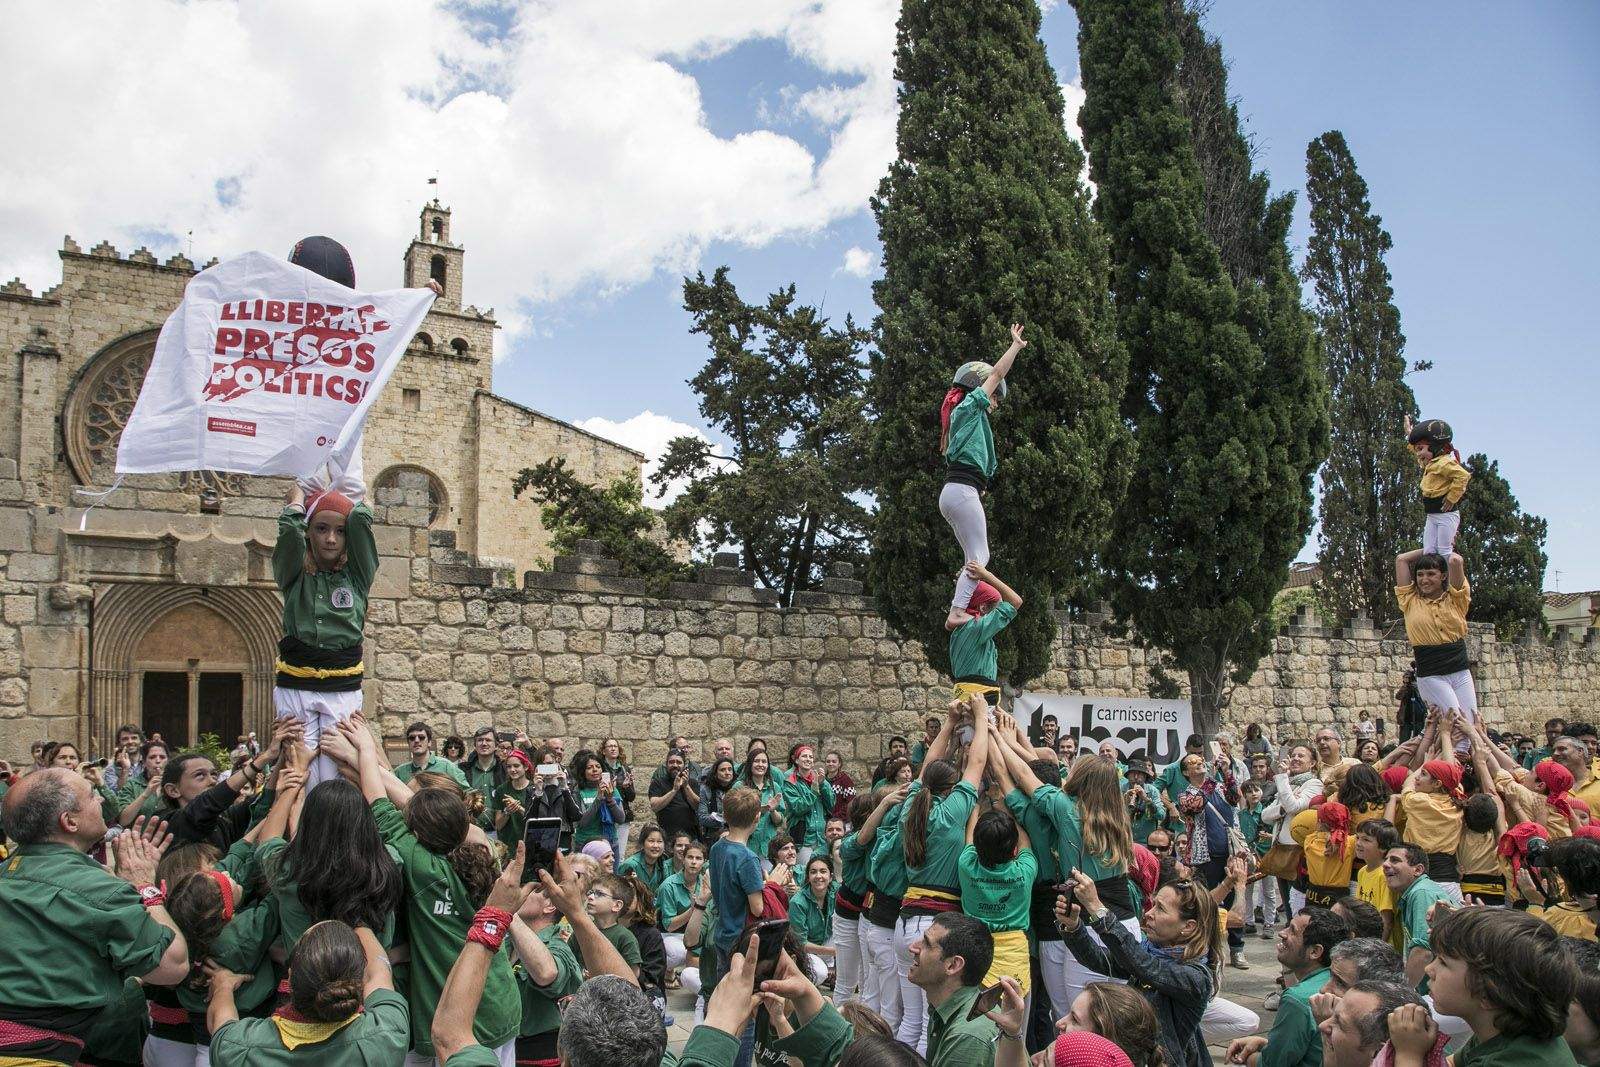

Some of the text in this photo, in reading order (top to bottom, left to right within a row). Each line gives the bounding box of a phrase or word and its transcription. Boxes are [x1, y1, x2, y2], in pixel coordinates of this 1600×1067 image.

[220, 299, 378, 335] LLIBERTAT
[214, 327, 376, 373] PRESOS
[1097, 705, 1178, 723] carnisseries
[433, 900, 454, 915] DE
